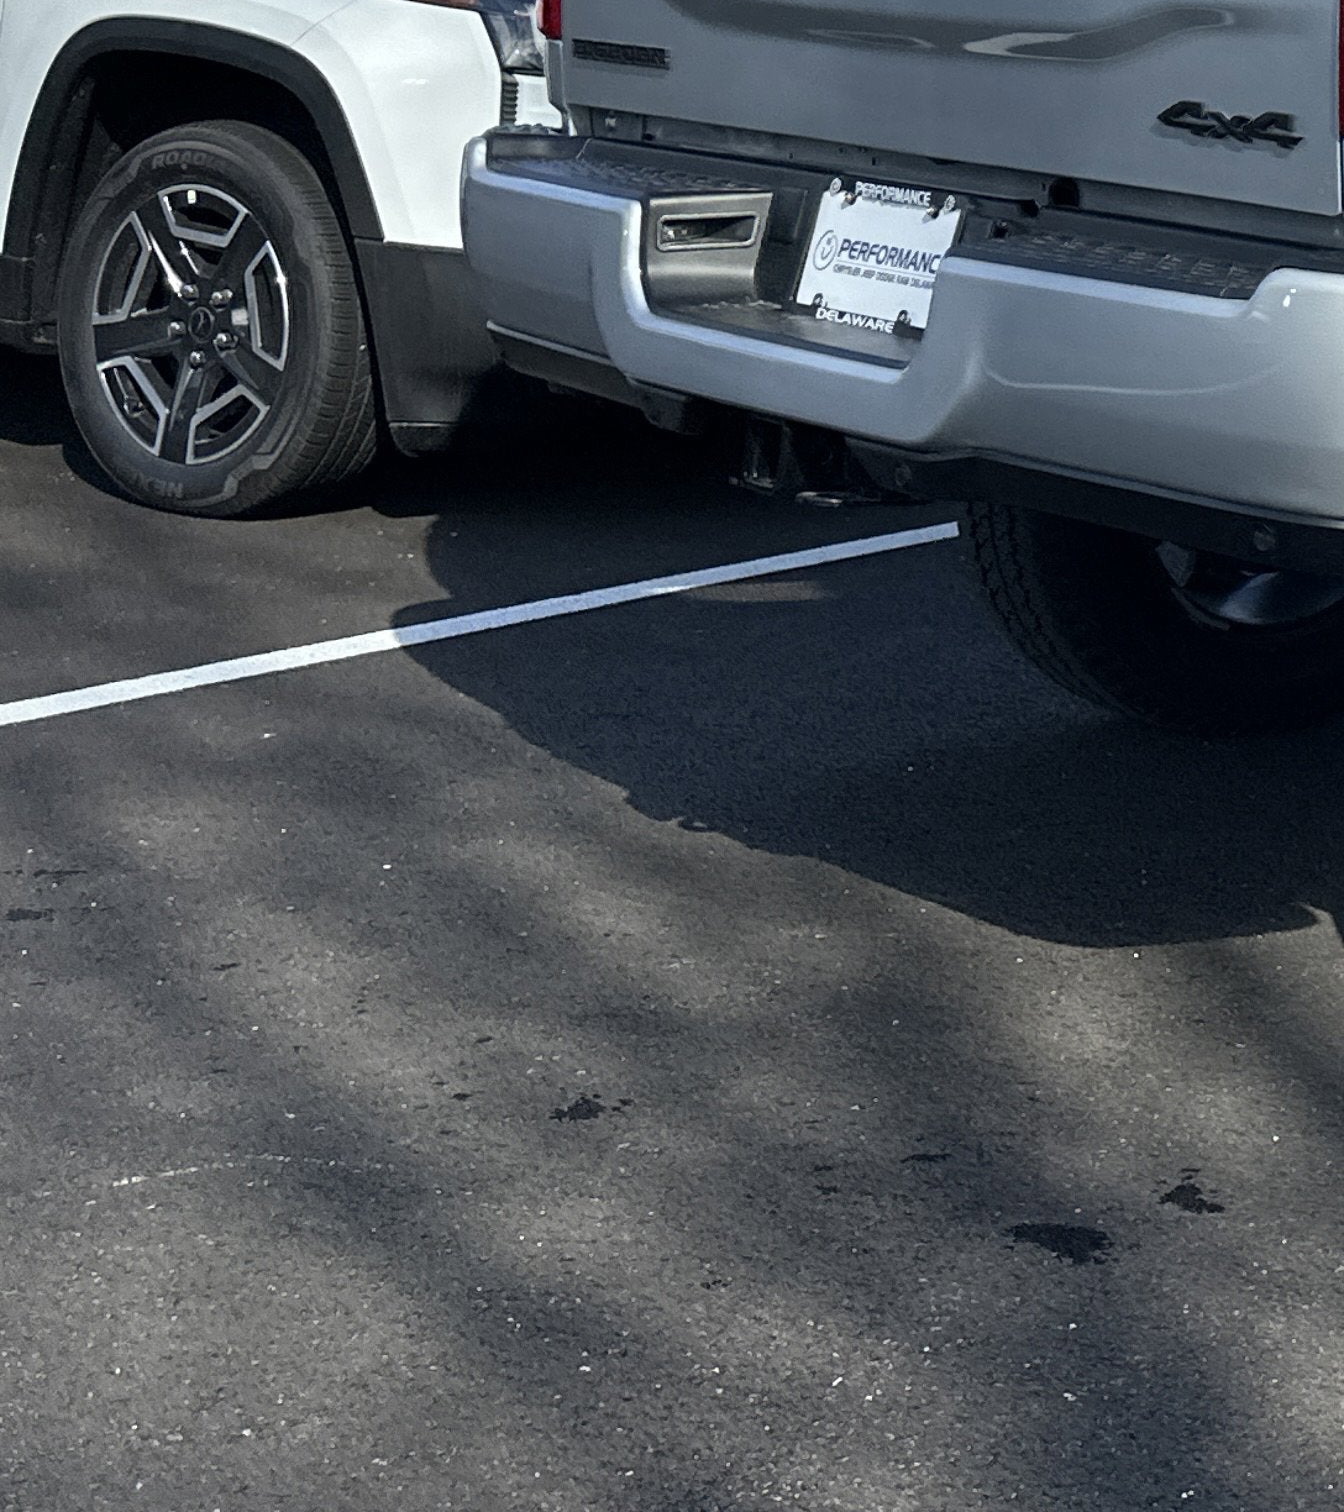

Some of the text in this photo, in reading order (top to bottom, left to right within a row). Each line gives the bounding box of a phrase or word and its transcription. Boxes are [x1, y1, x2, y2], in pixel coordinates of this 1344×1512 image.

[854, 180, 931, 207] PERFORMANCE
[837, 238, 941, 274] PERFORMANC
[815, 307, 894, 334] DELAWARE
